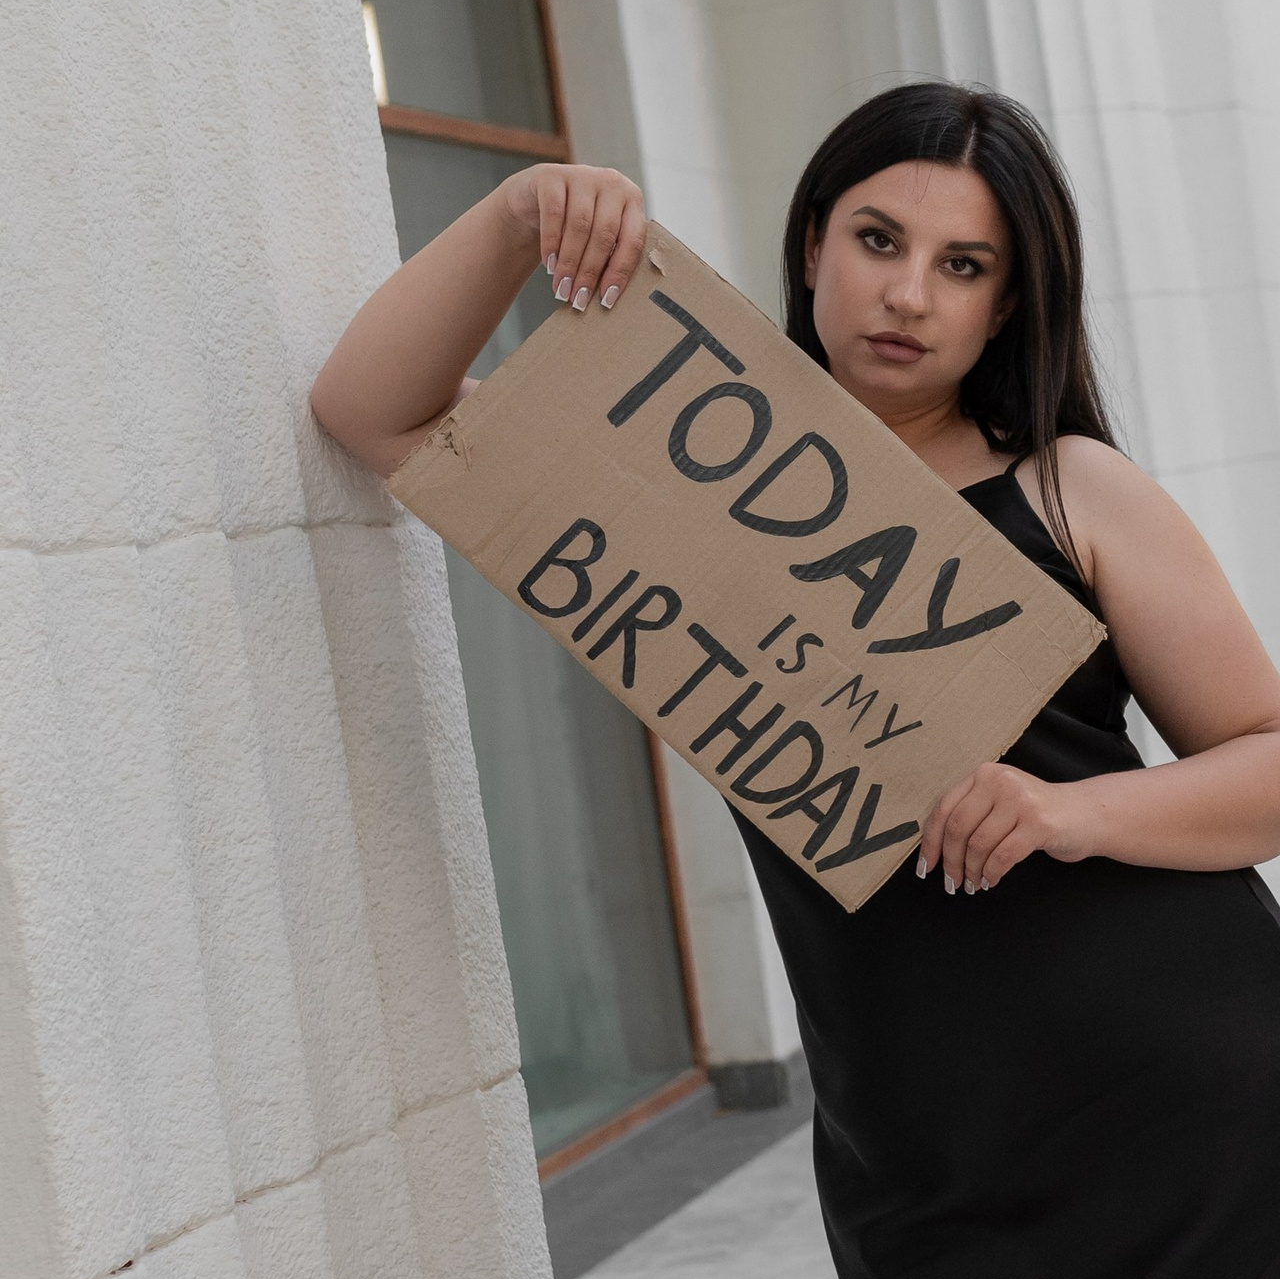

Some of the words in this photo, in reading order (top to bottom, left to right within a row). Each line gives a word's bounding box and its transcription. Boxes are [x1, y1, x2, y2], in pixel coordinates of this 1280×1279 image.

[607, 290, 1022, 654] TODAY
[517, 518, 920, 873] BIRTHDAY
[758, 614, 823, 673] IS
[821, 674, 923, 749] MY
